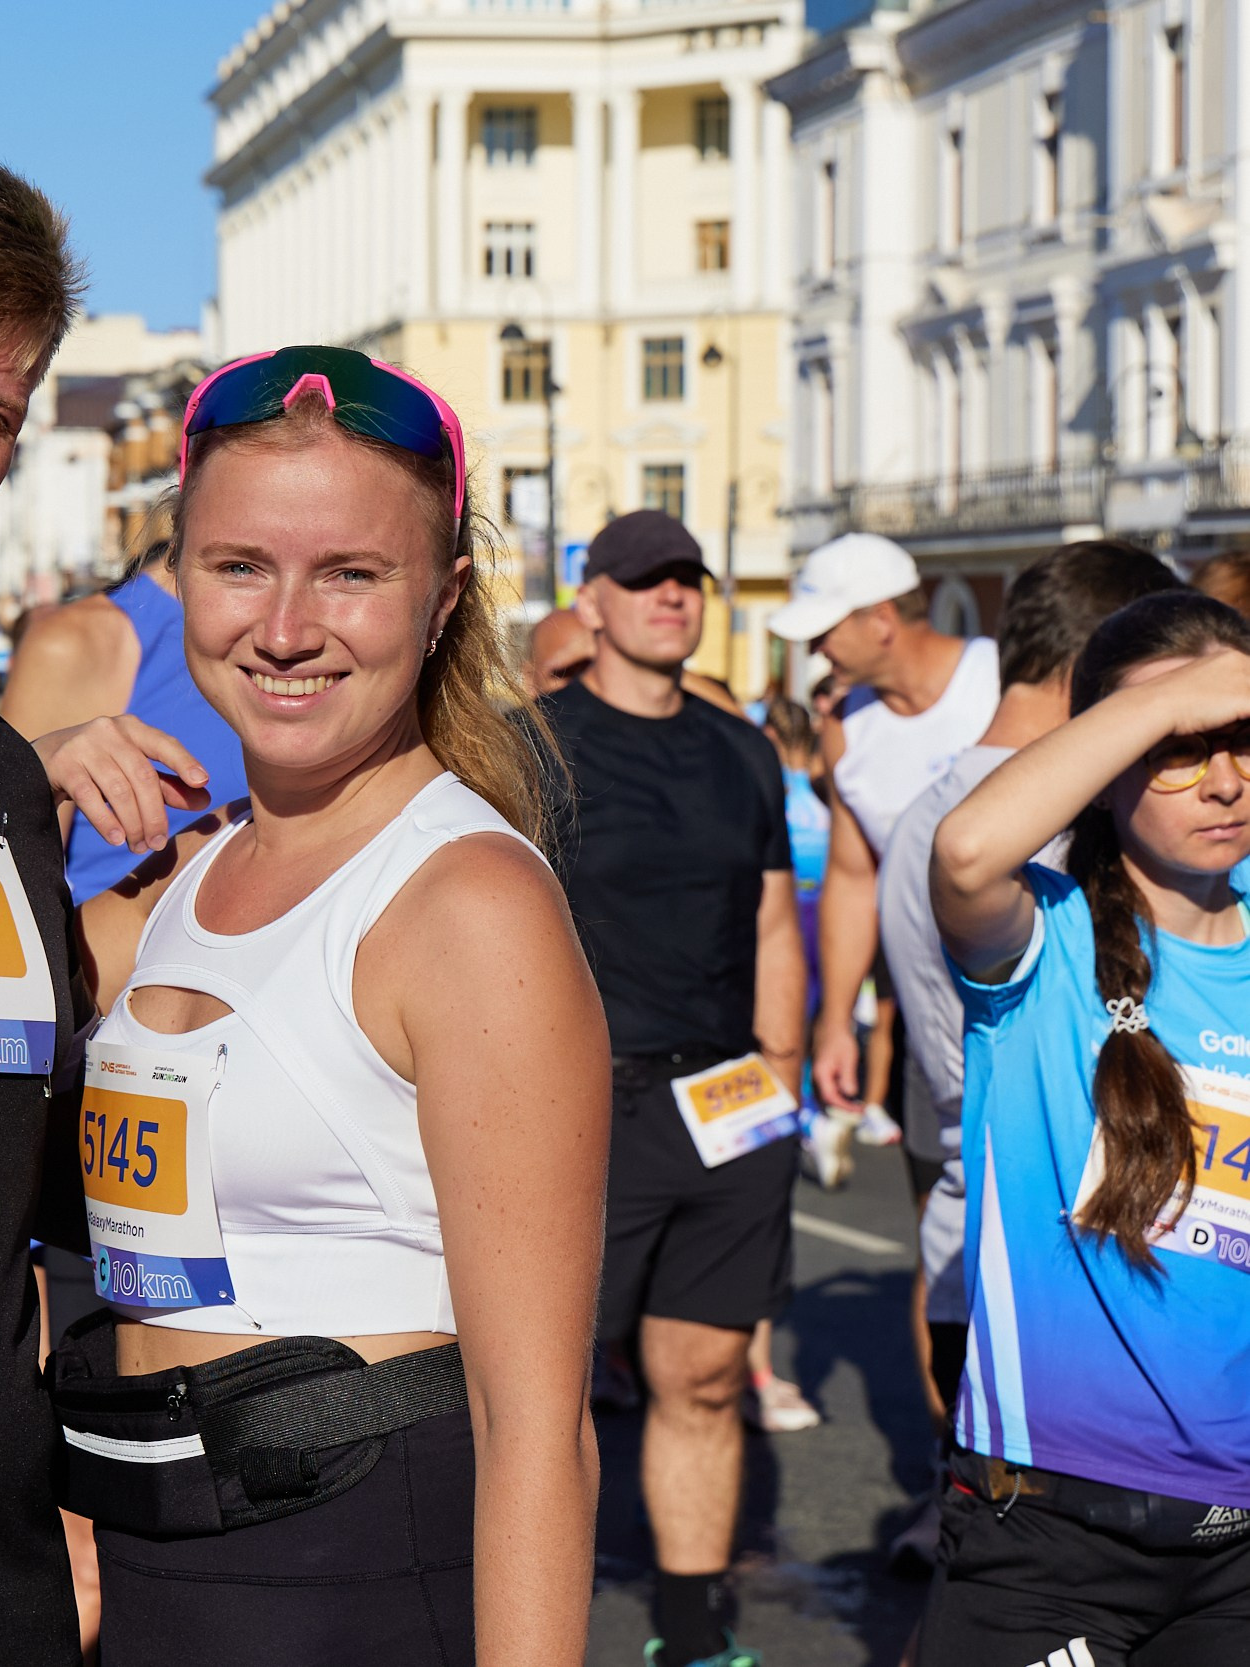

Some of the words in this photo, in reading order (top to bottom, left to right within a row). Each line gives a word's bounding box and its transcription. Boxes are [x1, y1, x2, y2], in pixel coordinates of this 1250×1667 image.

[101, 1061, 115, 1072] DNS
[84, 1110, 159, 1188] 5145
[1193, 1227, 1209, 1246] D
[99, 1257, 106, 1282] C
[113, 1260, 192, 1299] 10km
